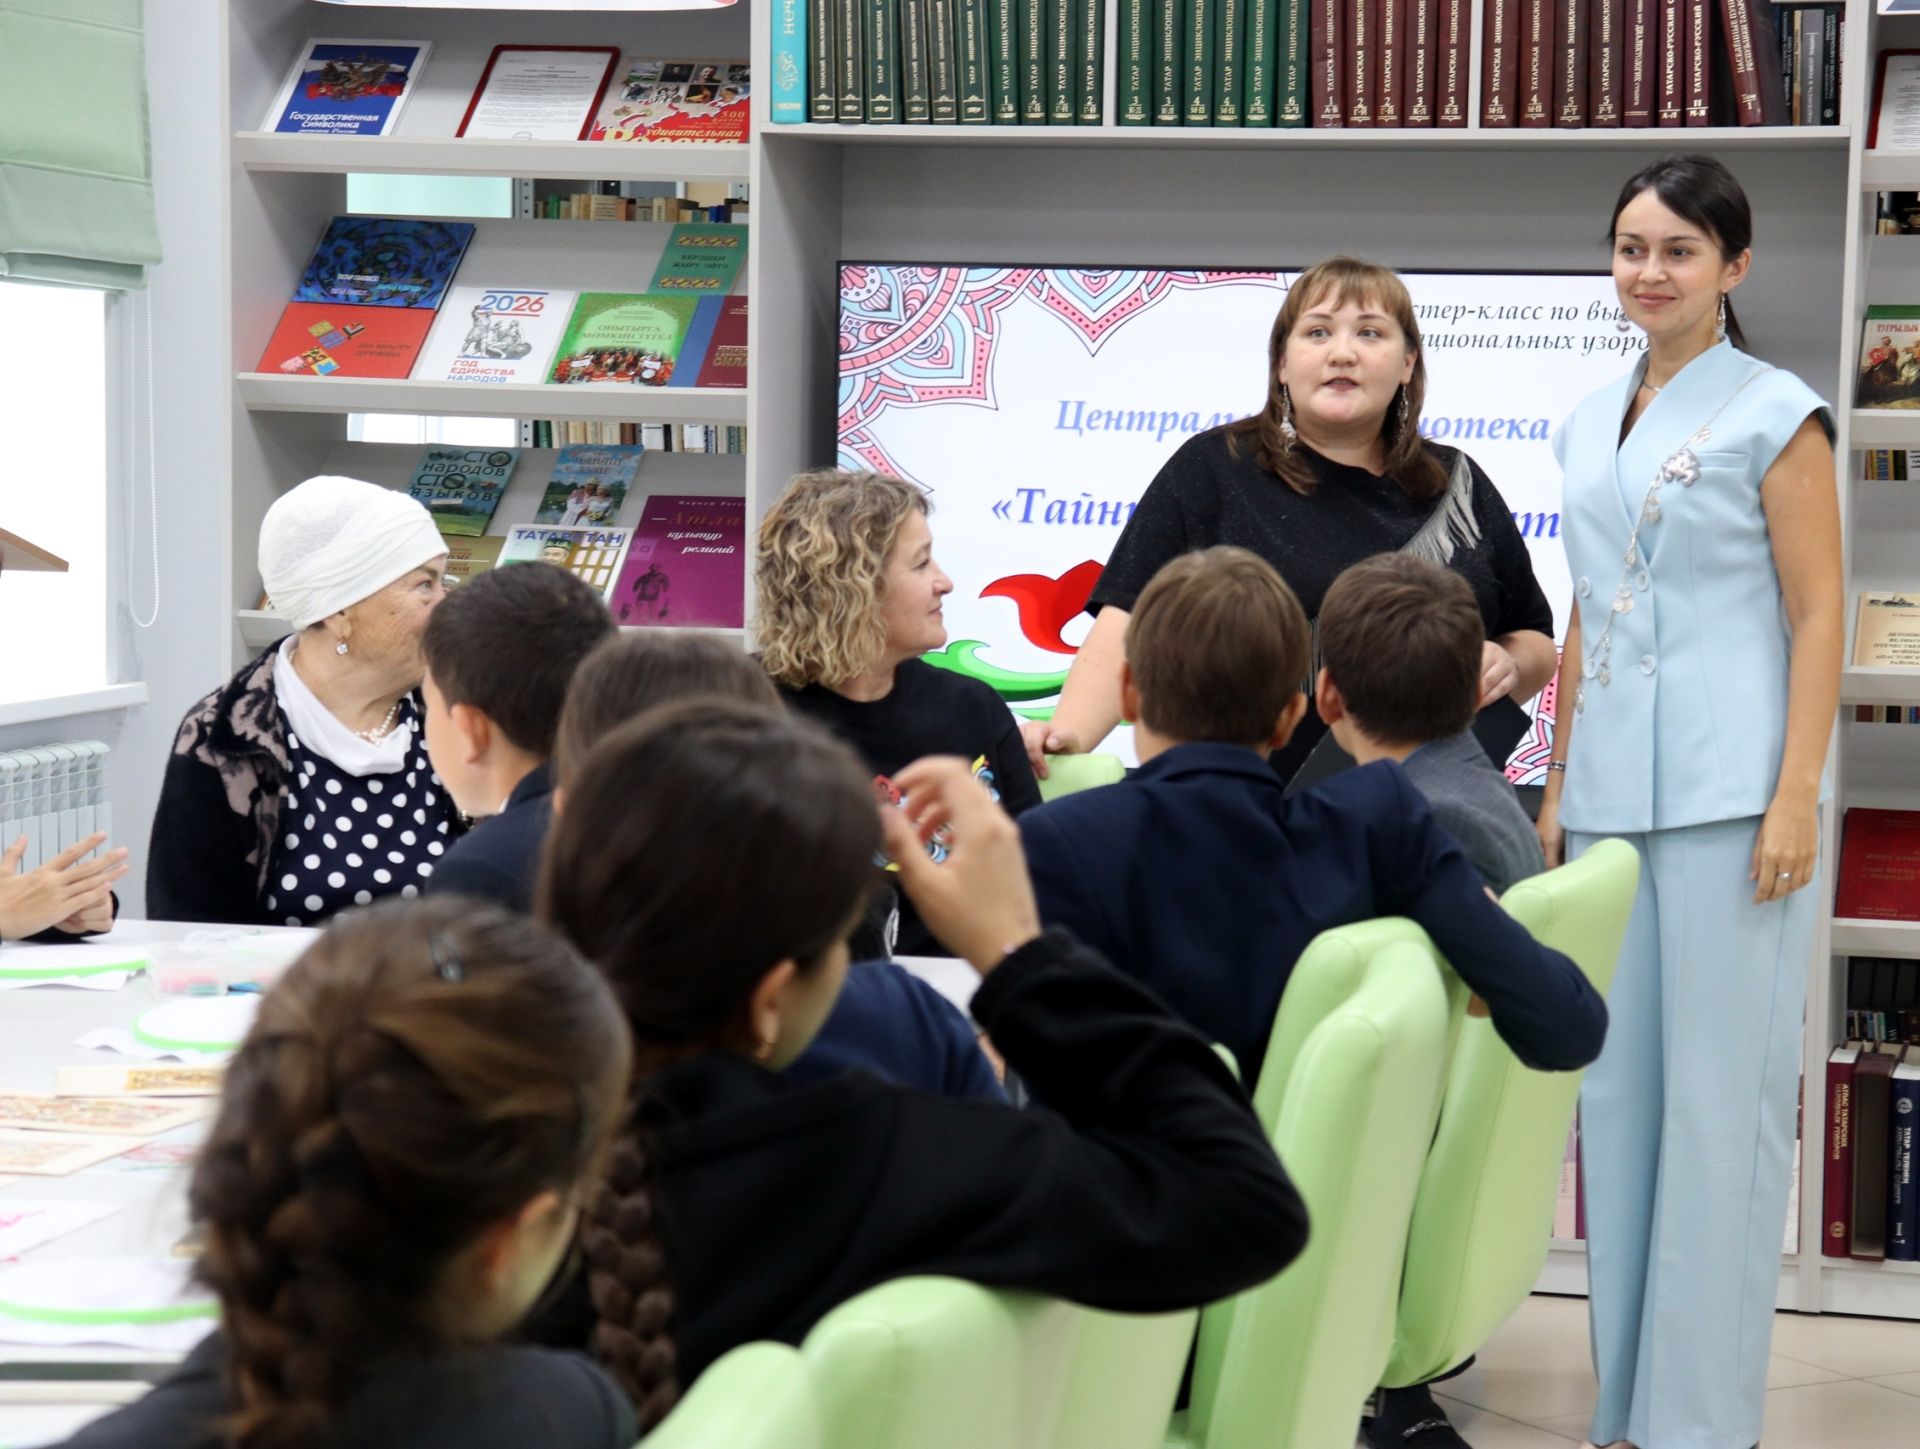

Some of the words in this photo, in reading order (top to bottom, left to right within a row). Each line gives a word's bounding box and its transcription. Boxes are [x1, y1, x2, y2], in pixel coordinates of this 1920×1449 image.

[1666, 7, 1675, 95] ТАТАРСКО-РУССКИЙ
[1693, 4, 1702, 93] ТАТАРСКО-РУССКИЙ
[1740, 23, 1754, 71] РЕСПУБЛИКИ
[968, 65, 976, 85] ТАТАР
[1326, 48, 1335, 92] ТАТАРСКАЯ
[1356, 50, 1364, 94] ТАТАРСКАЯ
[1384, 49, 1393, 93] ТАТАРСКАЯ
[1416, 49, 1424, 93] ТАТАРСКАЯ
[1448, 48, 1457, 93] ТАТАРСКАЯ
[1492, 48, 1501, 92] ТАТАРСКАЯ
[1531, 47, 1539, 91] ТАТАРСКАЯ
[1567, 48, 1575, 93] ТАТАРСКАЯ
[1602, 47, 1610, 92] ТАТАРСКАЯ
[1002, 64, 1010, 91] ТАТАР
[1030, 64, 1038, 91] ТАТАР
[1058, 64, 1067, 91] ТАТАР
[1086, 65, 1095, 92] ТАТАР
[1131, 65, 1140, 92] ТАТАР
[1164, 65, 1172, 92] ТАТАР
[1194, 65, 1202, 92] ТАТАР
[1224, 65, 1232, 92] ТАТАР
[1254, 65, 1263, 92] ТАТАР
[1288, 65, 1296, 92] ТАТАР
[1004, 95, 1009, 104] 1
[1031, 95, 1038, 104] 2
[1059, 95, 1065, 104] 2
[1087, 96, 1093, 104] 2
[1132, 96, 1139, 105] 3
[1165, 96, 1171, 105] 3
[1193, 96, 1200, 105] 4
[1224, 96, 1230, 105] 4
[1255, 96, 1261, 105] 5
[1288, 96, 1295, 105] 6
[1328, 96, 1333, 104] 1
[1357, 98, 1364, 106] 2
[1384, 97, 1391, 105] 2
[1417, 97, 1423, 105] 3
[1448, 97, 1455, 105] 3
[1492, 96, 1499, 105] 4
[1531, 94, 1538, 104] 4
[1568, 97, 1574, 105] 5
[1603, 95, 1609, 105] 5
[289, 112, 380, 122] Государственная
[301, 121, 360, 129] символика
[645, 127, 743, 137] удивительная
[480, 295, 545, 312] 2026
[1550, 306, 1579, 321] по
[450, 367, 516, 376] ЕДИНСТВА
[452, 360, 478, 368] ГОД
[446, 375, 507, 383] НАРОДОВ
[463, 450, 512, 468] СТО
[422, 462, 506, 477] народов
[417, 472, 467, 490] СТО
[410, 488, 493, 501] языков
[516, 530, 622, 543] ТАТАРСТАН
[666, 532, 723, 541] культур
[681, 545, 735, 555] религий
[1841, 1084, 1849, 1107] АТЛАС
[1840, 1108, 1849, 1148] ТАТАРСКИХ
[1832, 1126, 1840, 1160] ГОВОРОВ
[1903, 1126, 1911, 1149] ТАТАР
